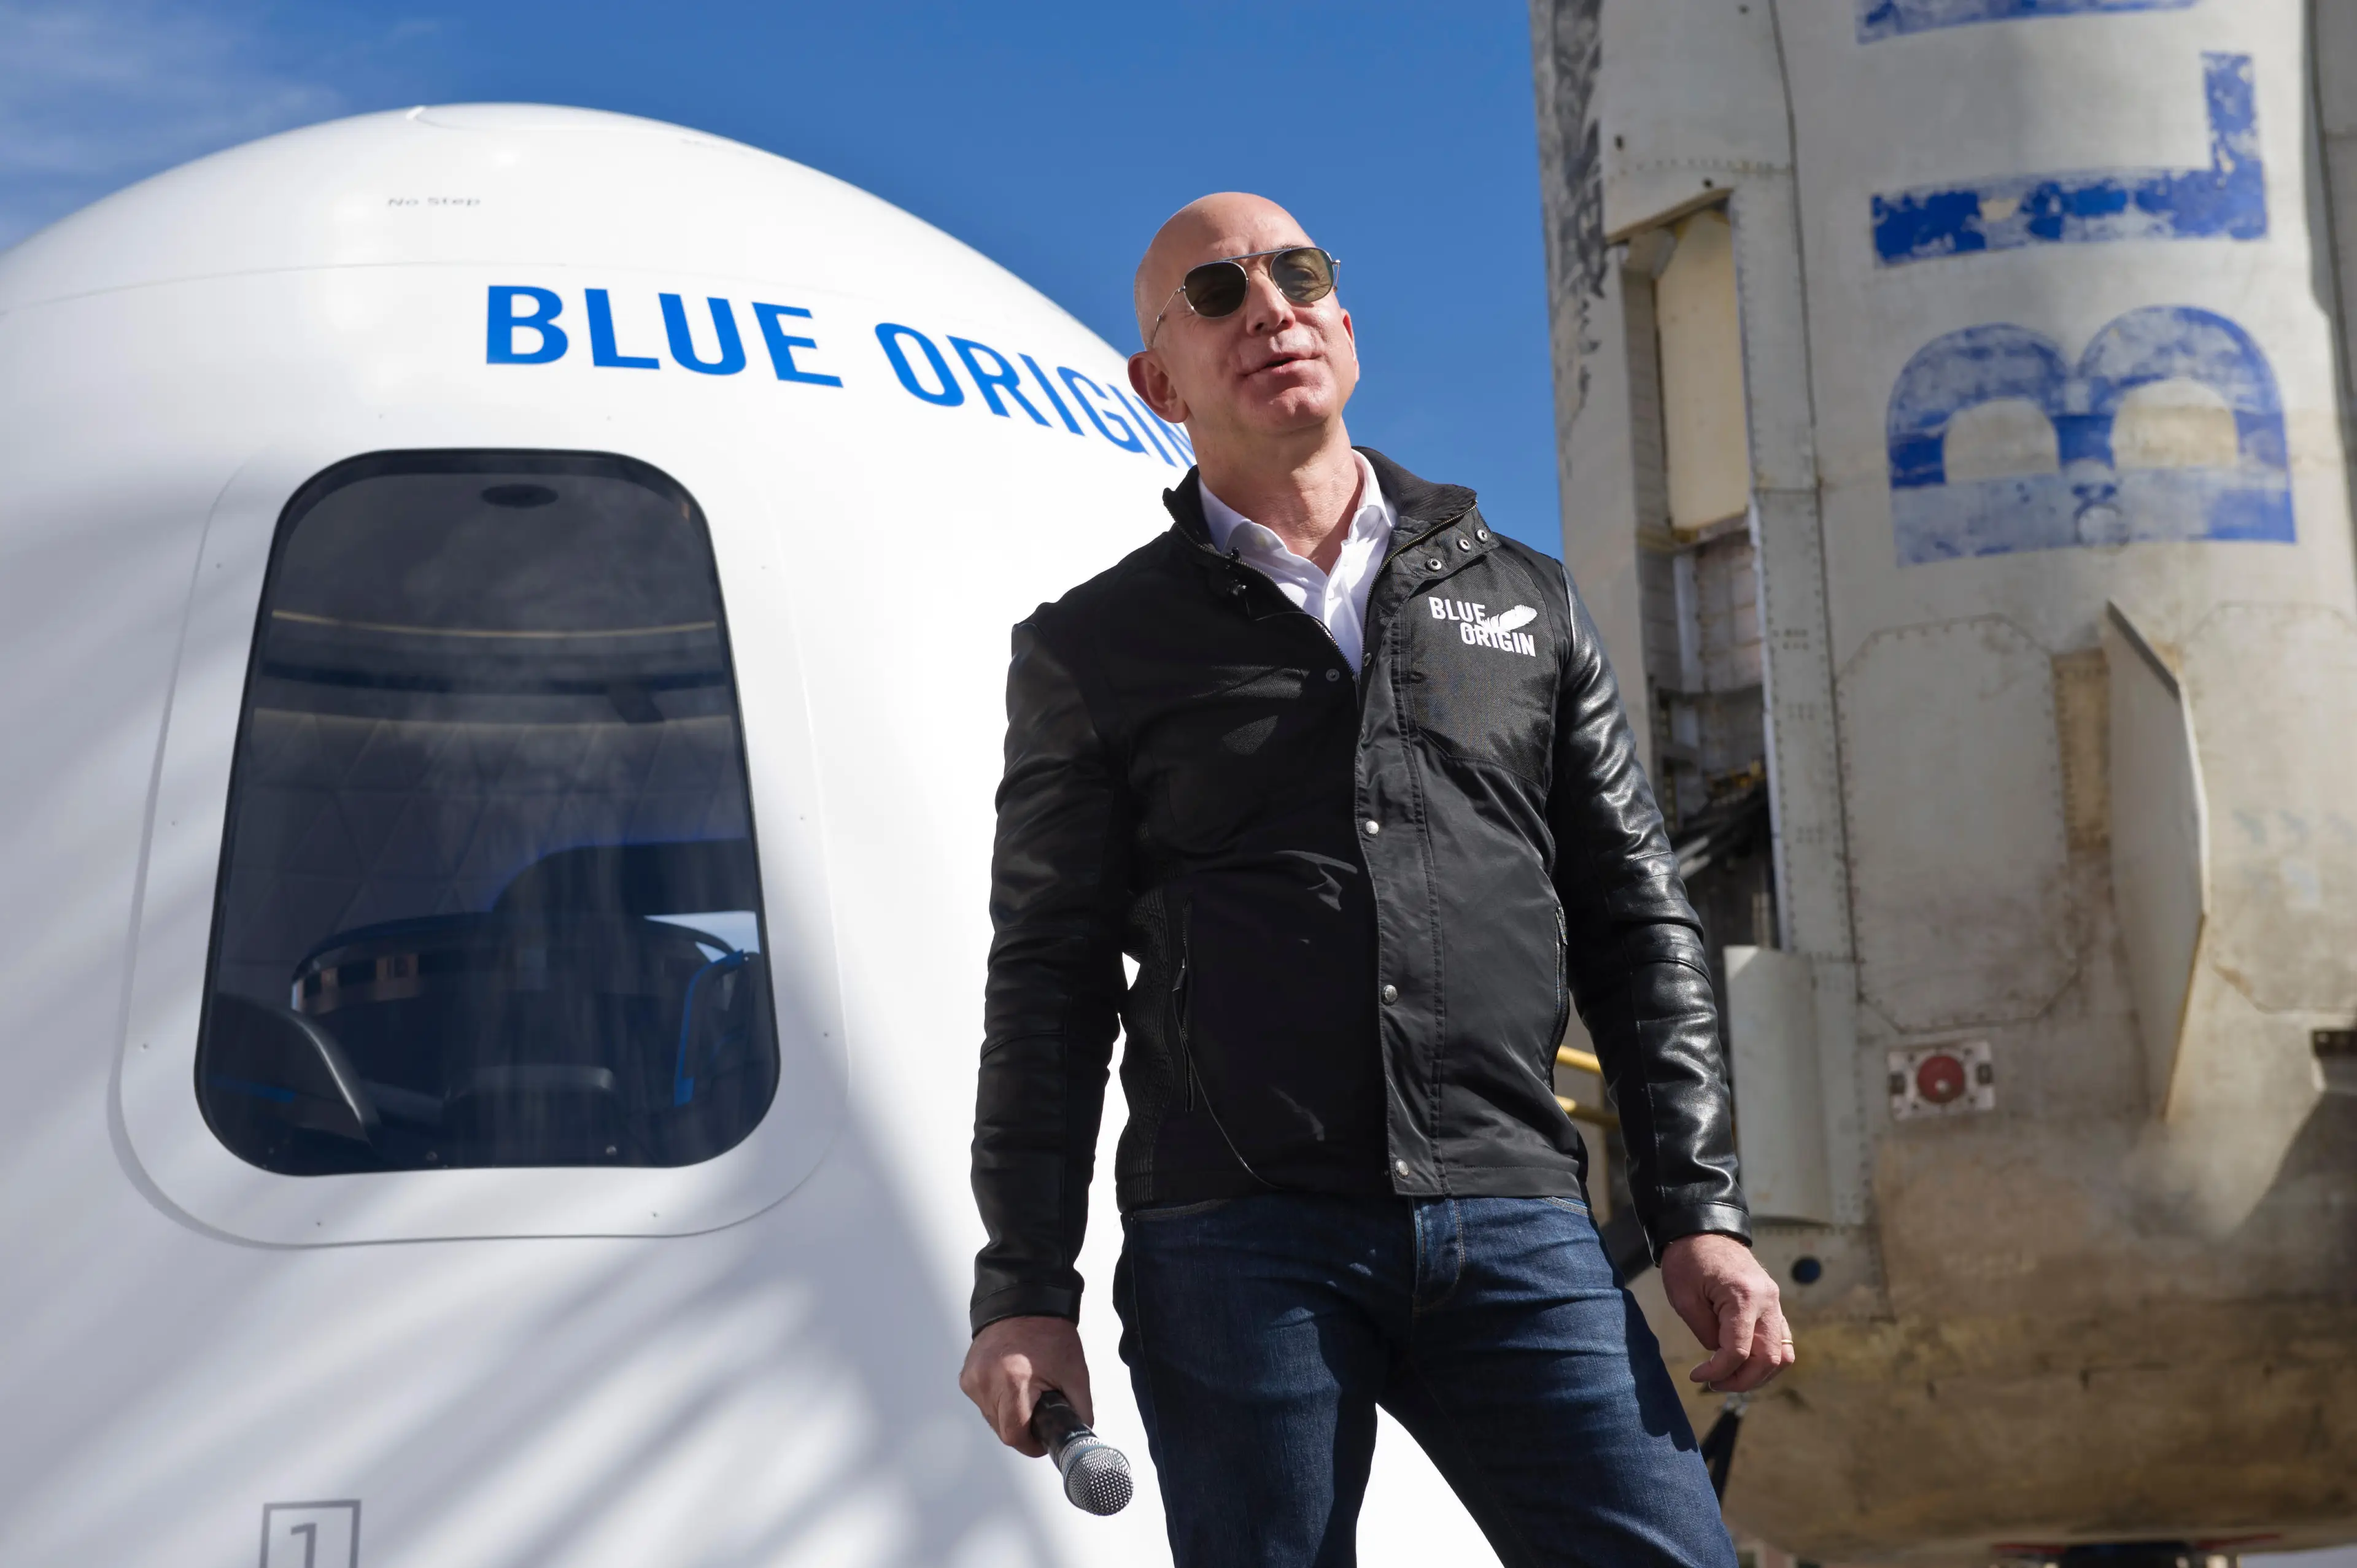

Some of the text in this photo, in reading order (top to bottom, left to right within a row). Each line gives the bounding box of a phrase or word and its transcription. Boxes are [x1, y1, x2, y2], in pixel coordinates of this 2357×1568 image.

[387, 196, 481, 207] No Step
[486, 285, 843, 388] BLUE
[1428, 597, 1485, 625] BLUE
[1460, 622, 1536, 657] ORIGIN
[290, 1523, 317, 1568] 1
